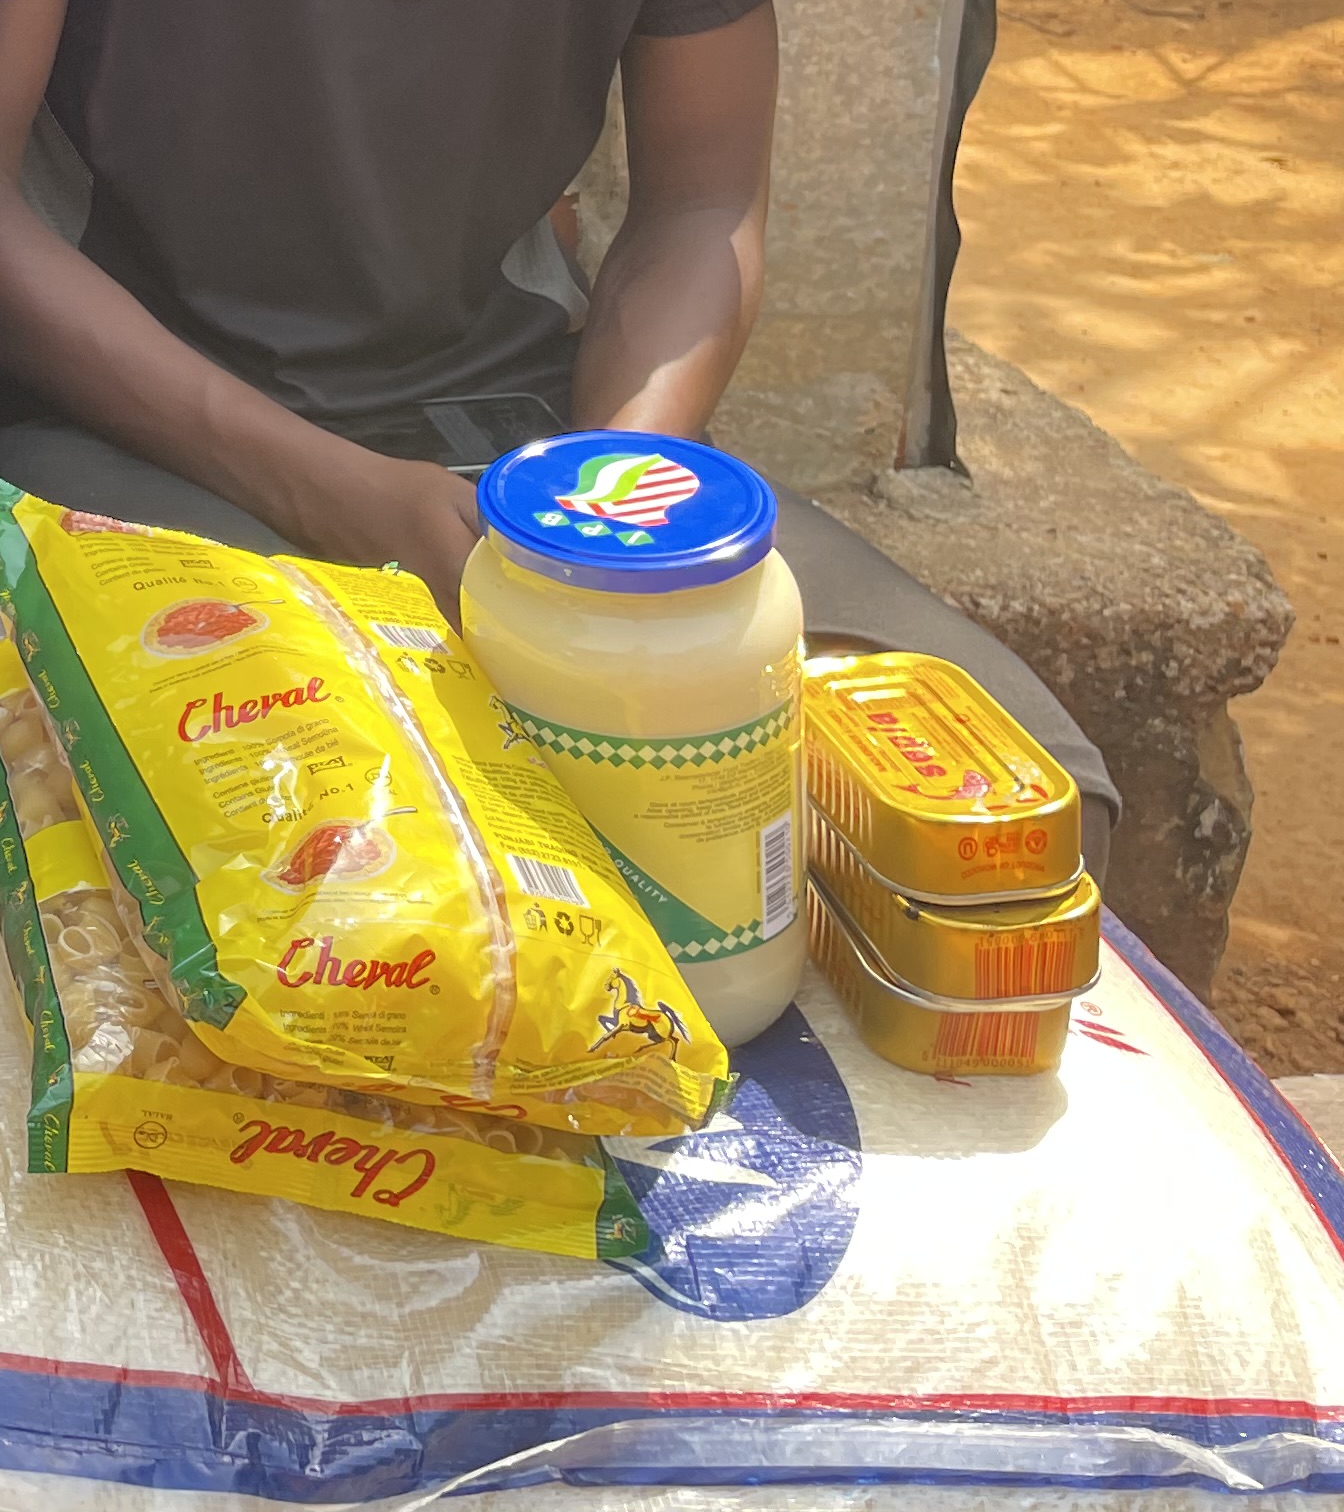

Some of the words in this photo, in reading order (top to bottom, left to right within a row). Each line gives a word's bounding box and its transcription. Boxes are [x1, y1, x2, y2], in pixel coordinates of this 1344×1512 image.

[177, 676, 332, 743] Cheval
[305, 718, 330, 733] grano
[301, 726, 339, 745] Semolina
[614, 858, 668, 903] QUALITY
[277, 935, 437, 991] Cheval
[140, 1109, 173, 1121] HALAL
[43, 1113, 60, 1173] Cheval
[230, 1120, 436, 1208] Cheval
